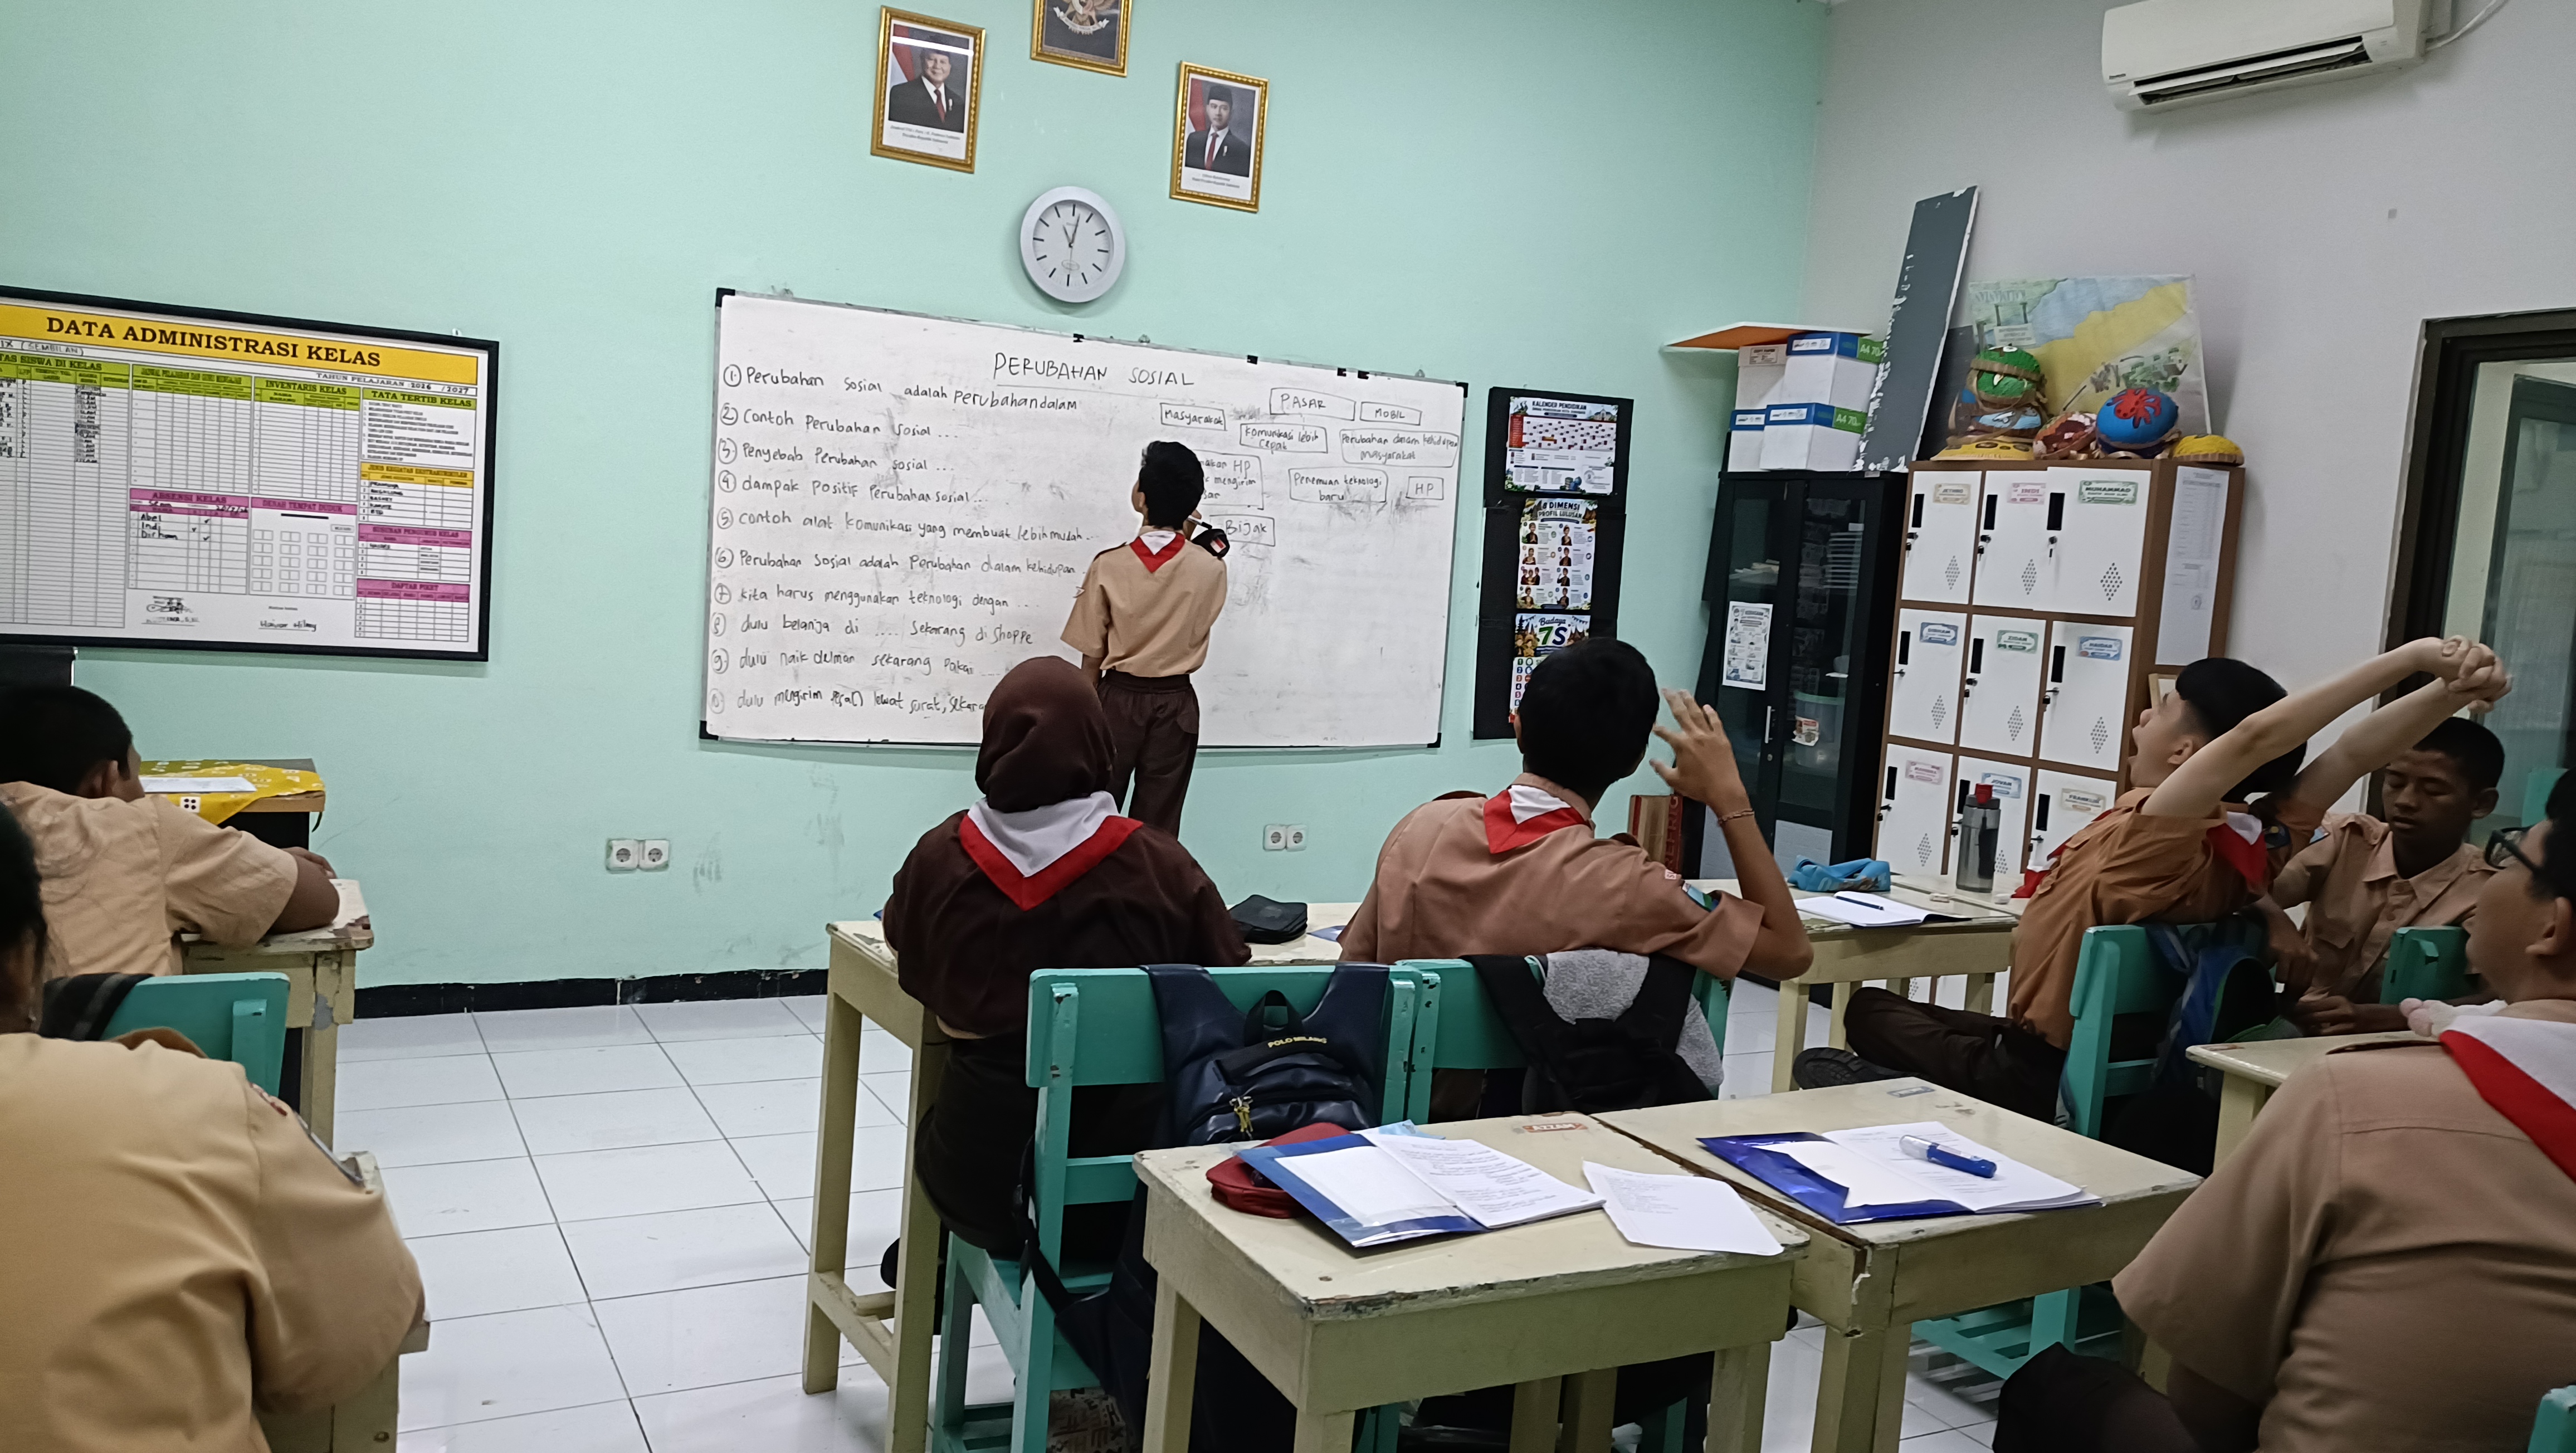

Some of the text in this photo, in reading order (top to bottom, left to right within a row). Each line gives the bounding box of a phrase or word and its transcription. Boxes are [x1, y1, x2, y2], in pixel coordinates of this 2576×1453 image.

[47, 317, 381, 367] DATA ADMINISTRASI KELAS
[20, 355, 52, 367] SISWA
[69, 360, 103, 371] KELAS
[993, 352, 1194, 386] PERUBAHAN SOSIAL
[266, 379, 347, 395] INVENTARIS KELAS
[316, 372, 404, 387] TAHUN PELAJARAN
[371, 391, 472, 407] TATA TERTIB KELAS
[904, 384, 948, 399] adalah
[1280, 393, 1326, 409] PASAR
[1374, 408, 1406, 419] MOBIL
[1214, 476, 1256, 490] mengirim
[1344, 474, 1382, 489] teknologi
[1415, 482, 1435, 495] HP
[152, 492, 193, 502] ABSENSI
[196, 495, 227, 504] KELAS
[1319, 490, 1344, 501] baru
[1549, 502, 1580, 511] DIMENSI
[1559, 510, 1583, 519] LULUSAN
[802, 515, 834, 529] alat
[918, 522, 947, 539] yang
[953, 525, 1012, 539] membuat
[858, 553, 899, 569] adalah
[980, 553, 1022, 573] dalam
[775, 583, 814, 602] harus
[824, 588, 900, 608] menggunakan
[908, 590, 963, 610] teknologi
[972, 593, 1009, 616] dengan
[844, 618, 859, 635] di
[1539, 617, 1567, 626] Budaya
[1538, 626, 1568, 646] 7S
[1267, 1037, 1293, 1048] POLO
